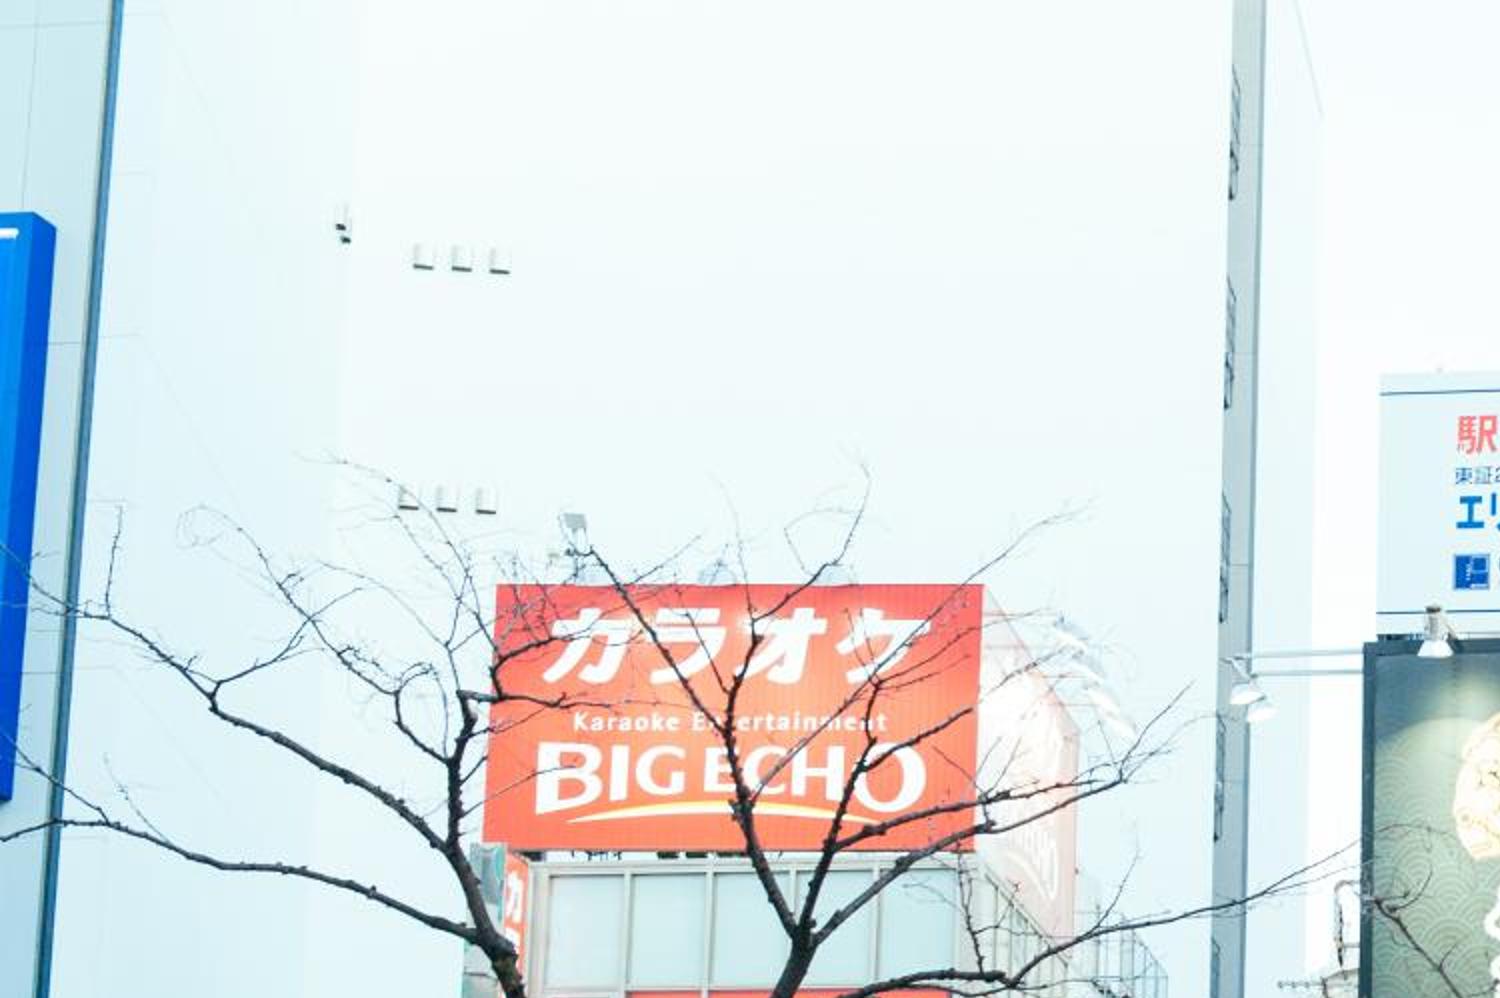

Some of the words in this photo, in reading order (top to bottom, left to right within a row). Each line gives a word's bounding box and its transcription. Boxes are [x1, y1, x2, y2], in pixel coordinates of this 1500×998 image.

[543, 606, 932, 686] カラオケ
[573, 711, 681, 732] Karaoke
[692, 710, 888, 733] Enertainment
[536, 741, 685, 817] BIG
[704, 741, 927, 813] ECHO
